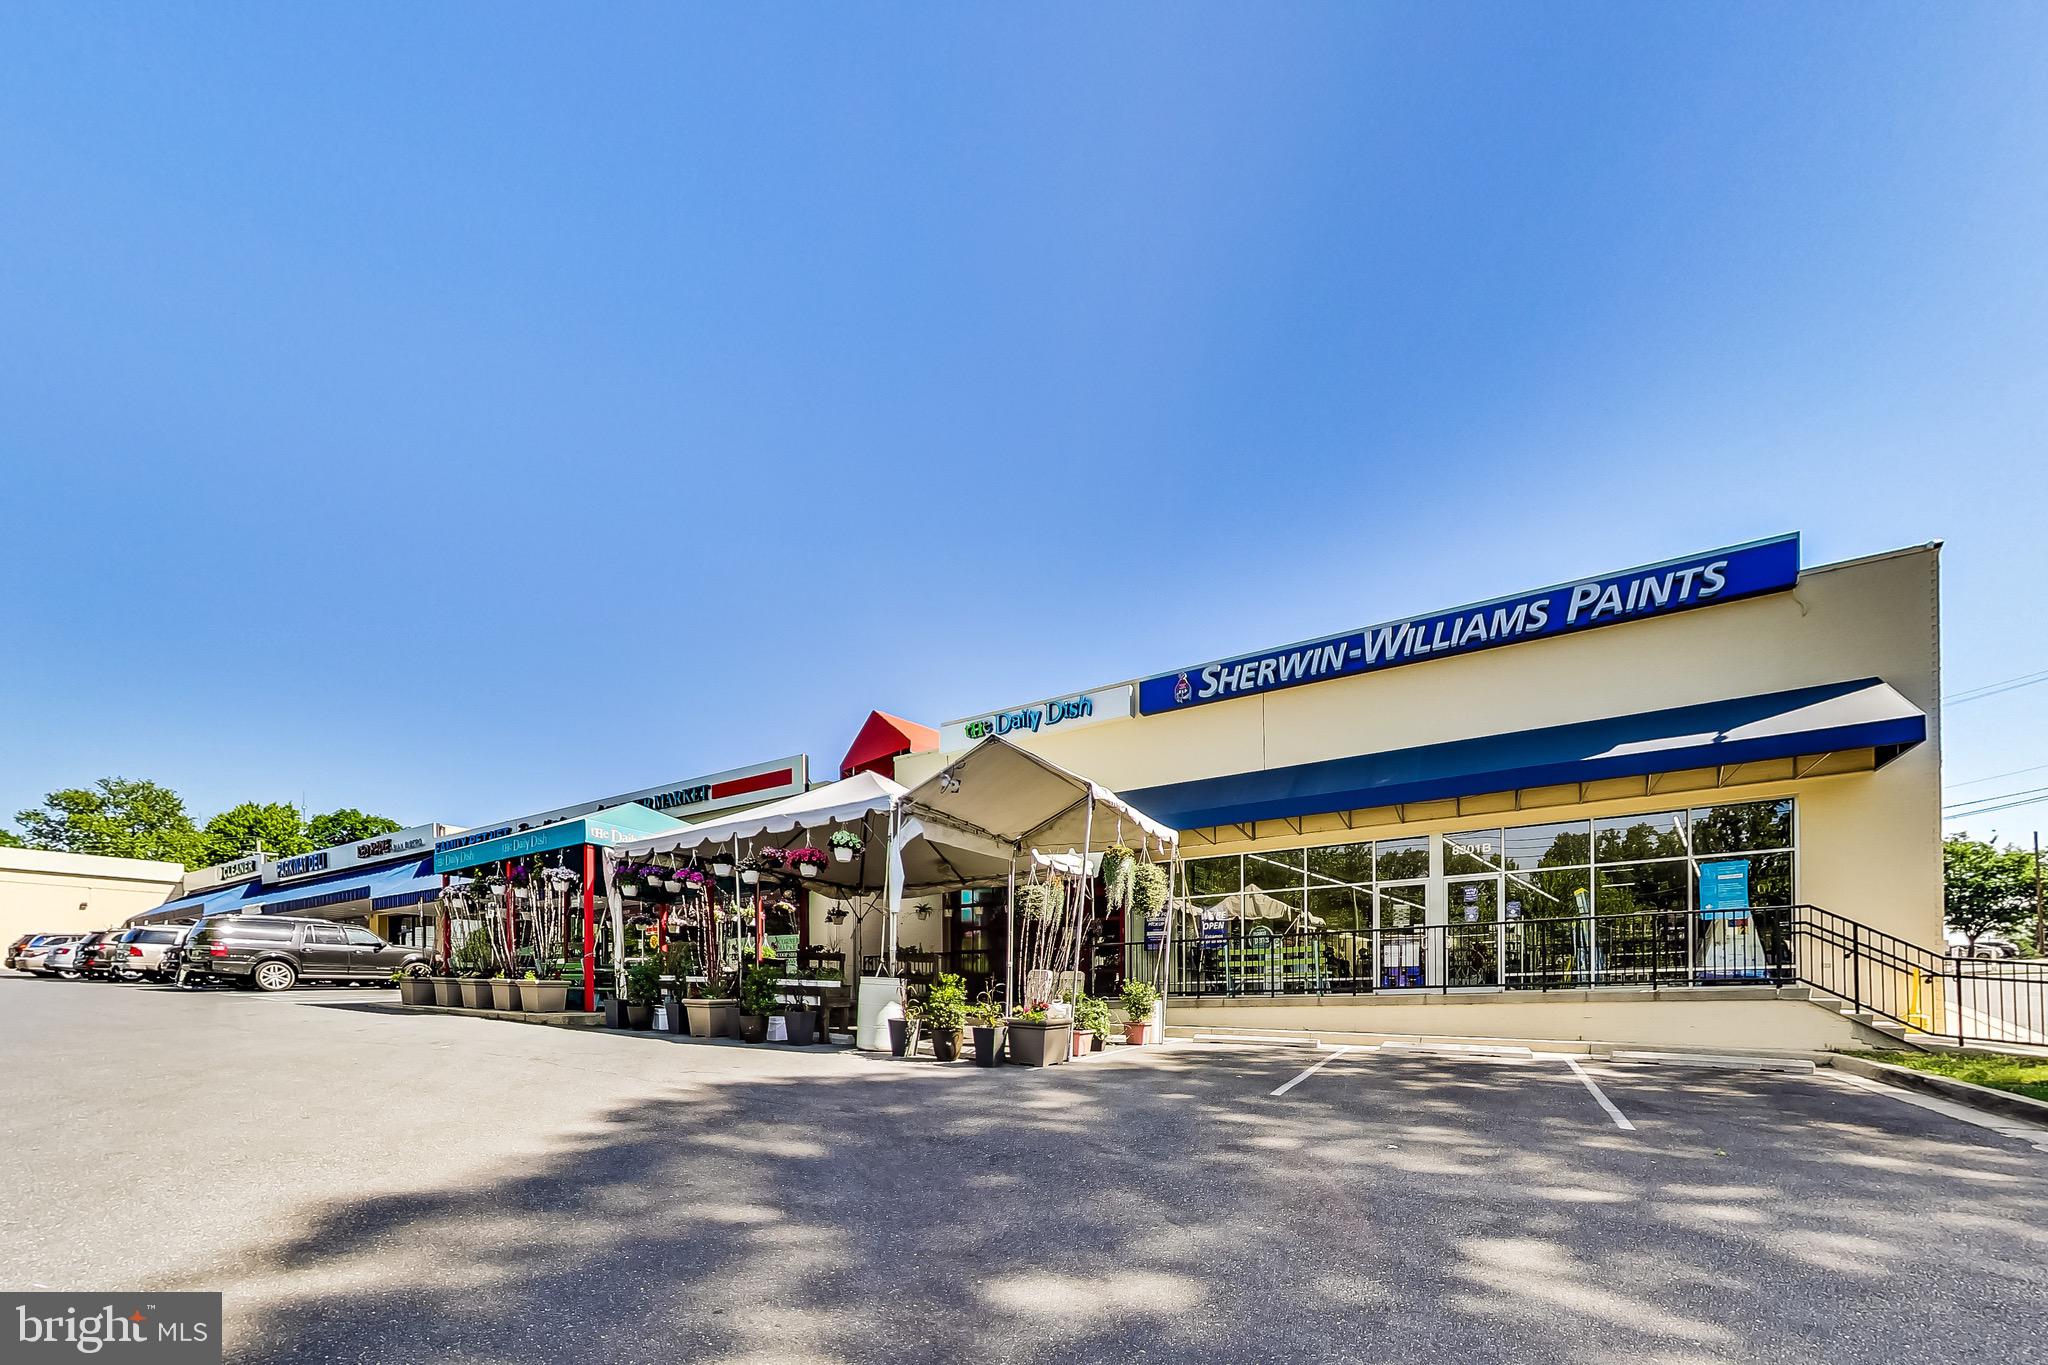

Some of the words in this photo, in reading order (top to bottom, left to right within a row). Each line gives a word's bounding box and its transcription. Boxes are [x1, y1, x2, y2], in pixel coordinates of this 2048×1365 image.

[1198, 599, 1550, 699] SHERWIN-WILLIAMS
[1566, 561, 1728, 625] PAINTS
[994, 709, 1042, 735] Daily
[1044, 696, 1093, 726] Dish
[653, 784, 711, 810] MARKET
[611, 827, 640, 844] Dail
[276, 856, 307, 878] PARKWAY
[308, 852, 328, 871] DELI
[1203, 921, 1225, 930] OPEN
